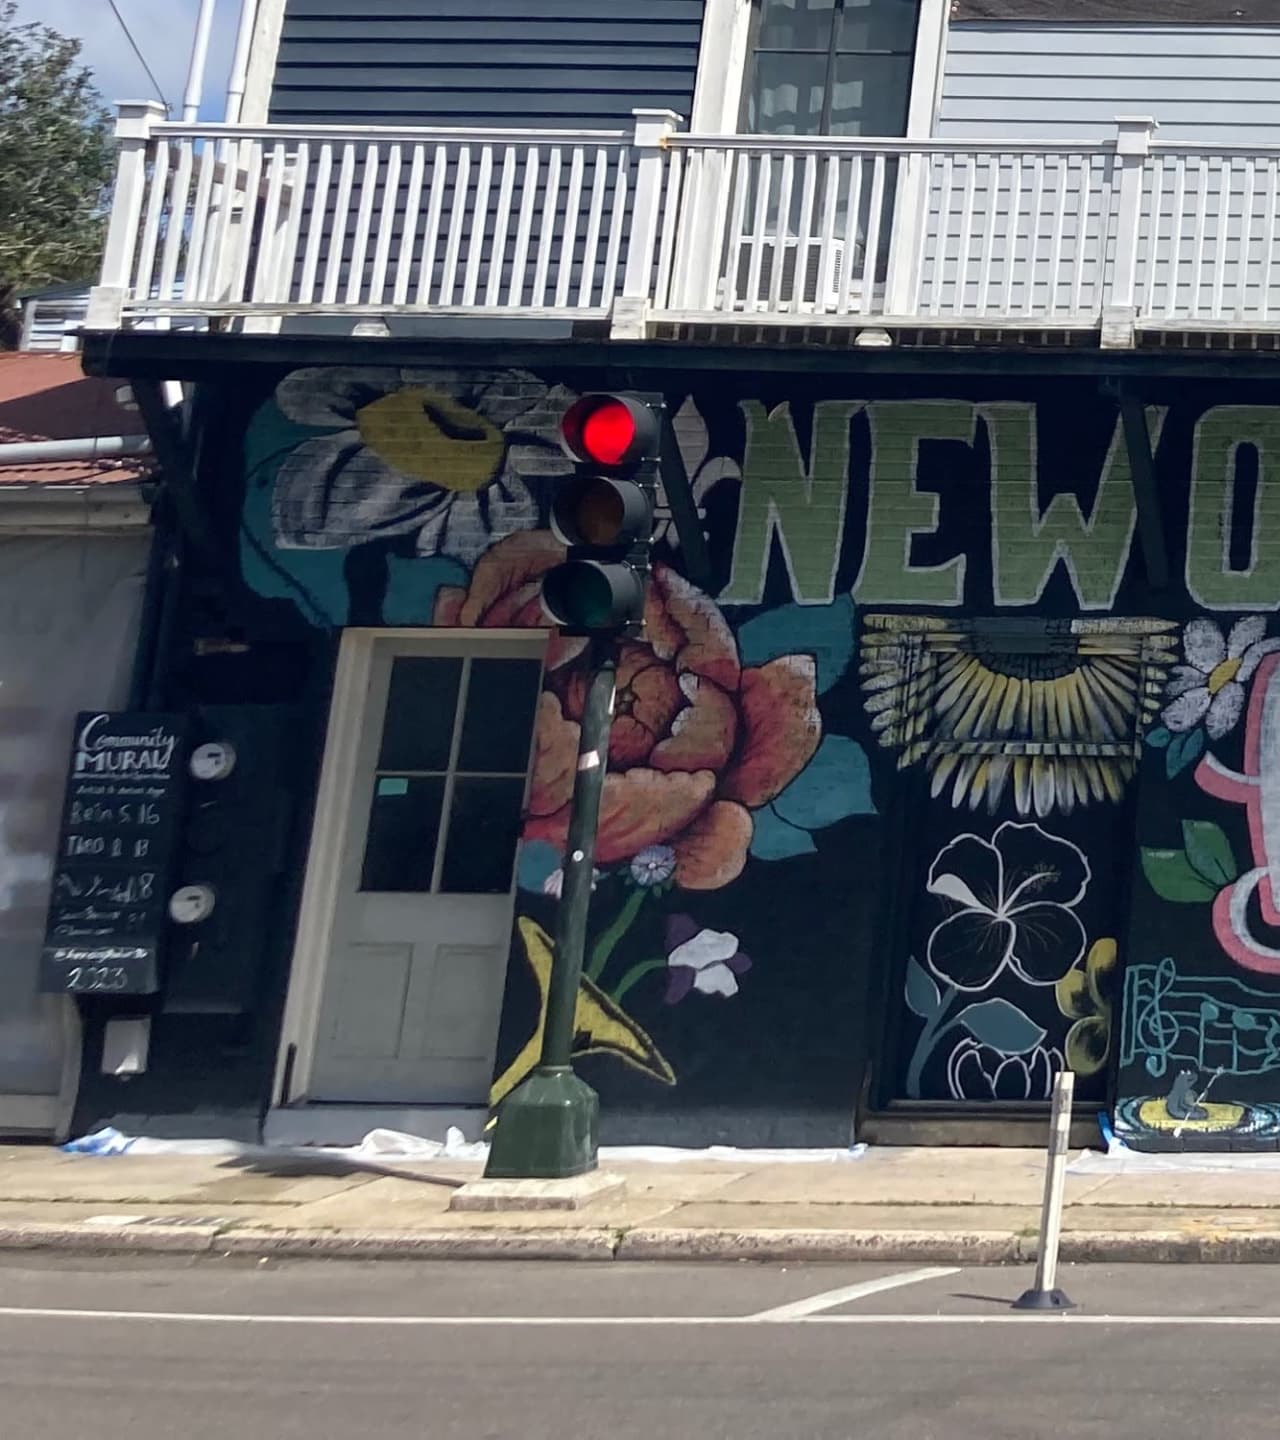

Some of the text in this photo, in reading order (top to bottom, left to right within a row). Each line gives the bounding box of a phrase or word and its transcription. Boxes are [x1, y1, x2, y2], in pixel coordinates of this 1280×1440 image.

[717, 398, 1170, 612] NEW
[75, 749, 166, 772] MURAL
[79, 713, 176, 769] Community
